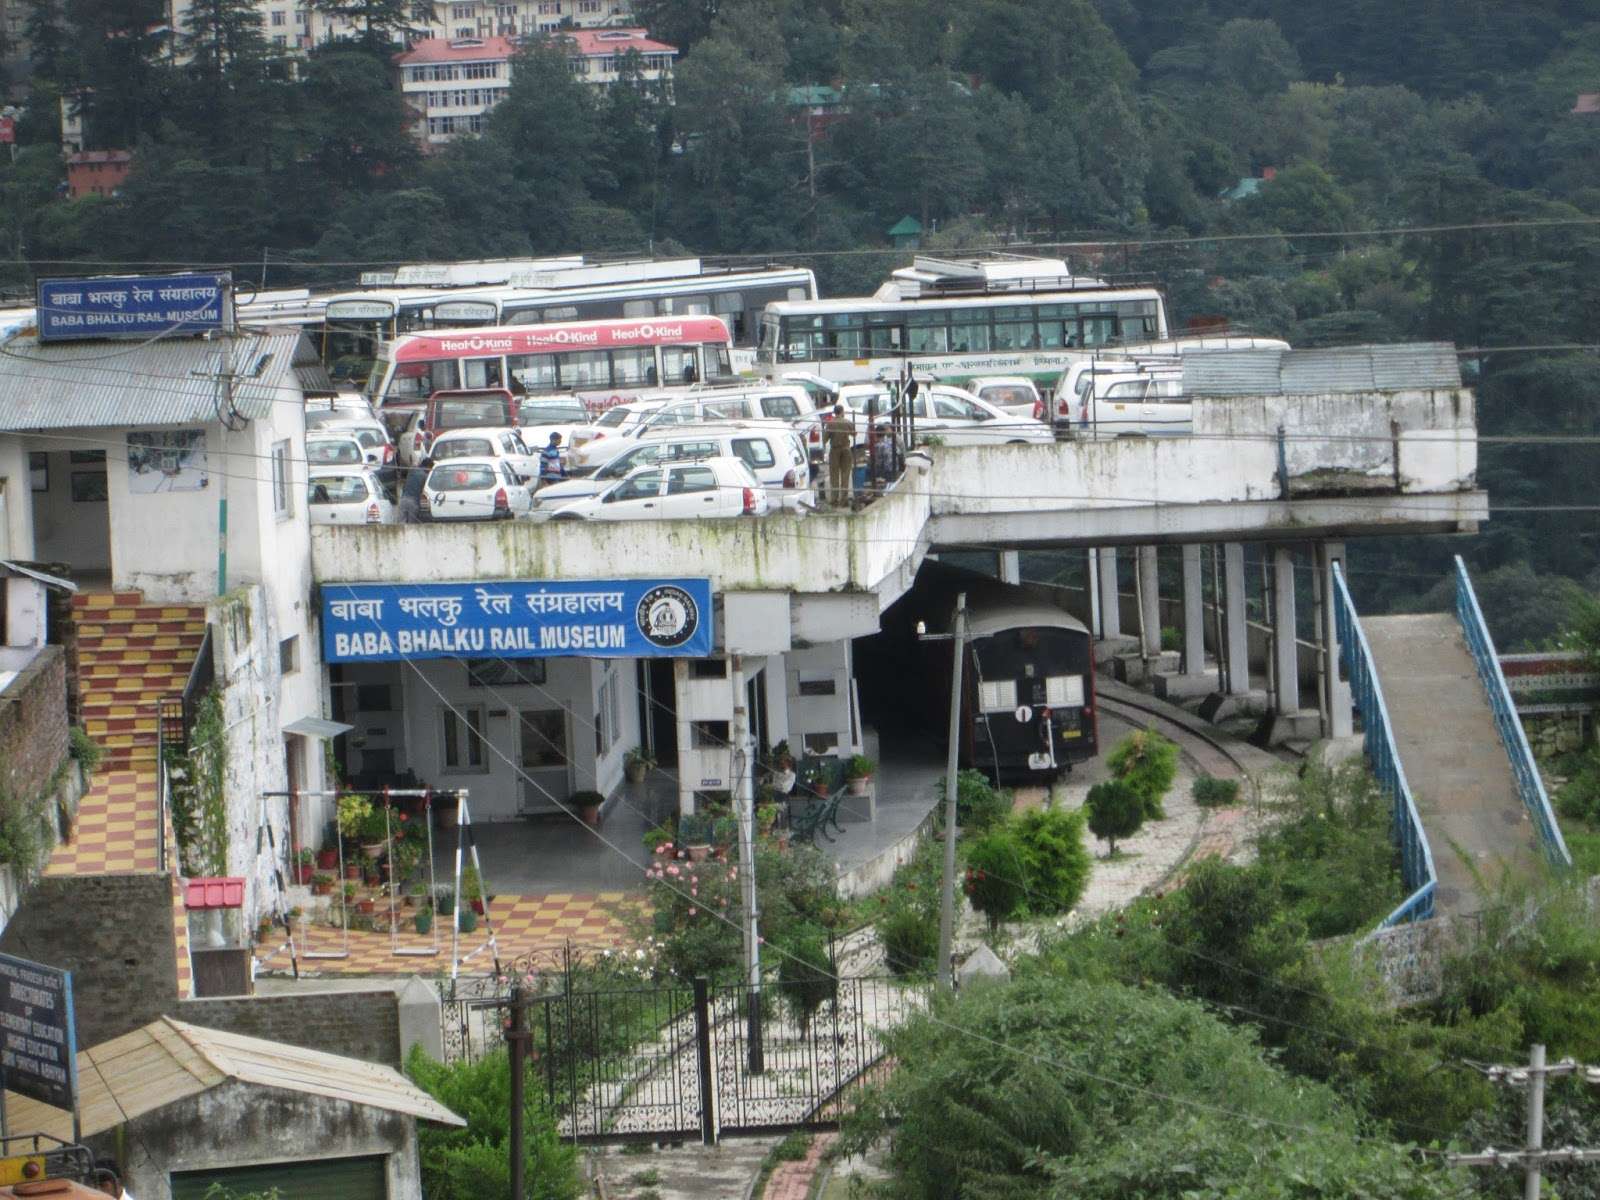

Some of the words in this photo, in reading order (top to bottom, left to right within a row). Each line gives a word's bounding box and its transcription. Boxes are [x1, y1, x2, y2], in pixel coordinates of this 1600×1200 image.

[51, 292, 82, 305] बाबा
[88, 291, 128, 308] भलकु
[133, 286, 153, 302] रेल
[159, 285, 217, 301] संग्रहालय
[51, 315, 84, 327] BABA
[86, 313, 134, 325] BHALKU
[137, 312, 164, 323] RAIL
[167, 310, 218, 321] MUSEUM
[330, 600, 384, 621] बाबा
[399, 596, 463, 626] भलकु
[474, 588, 512, 615] रेल
[525, 588, 625, 614] संग्रहालय
[335, 632, 393, 656] BABA
[398, 628, 484, 653] BHALKU
[490, 626, 536, 650] RAIL
[540, 625, 626, 649] MUSEUM
